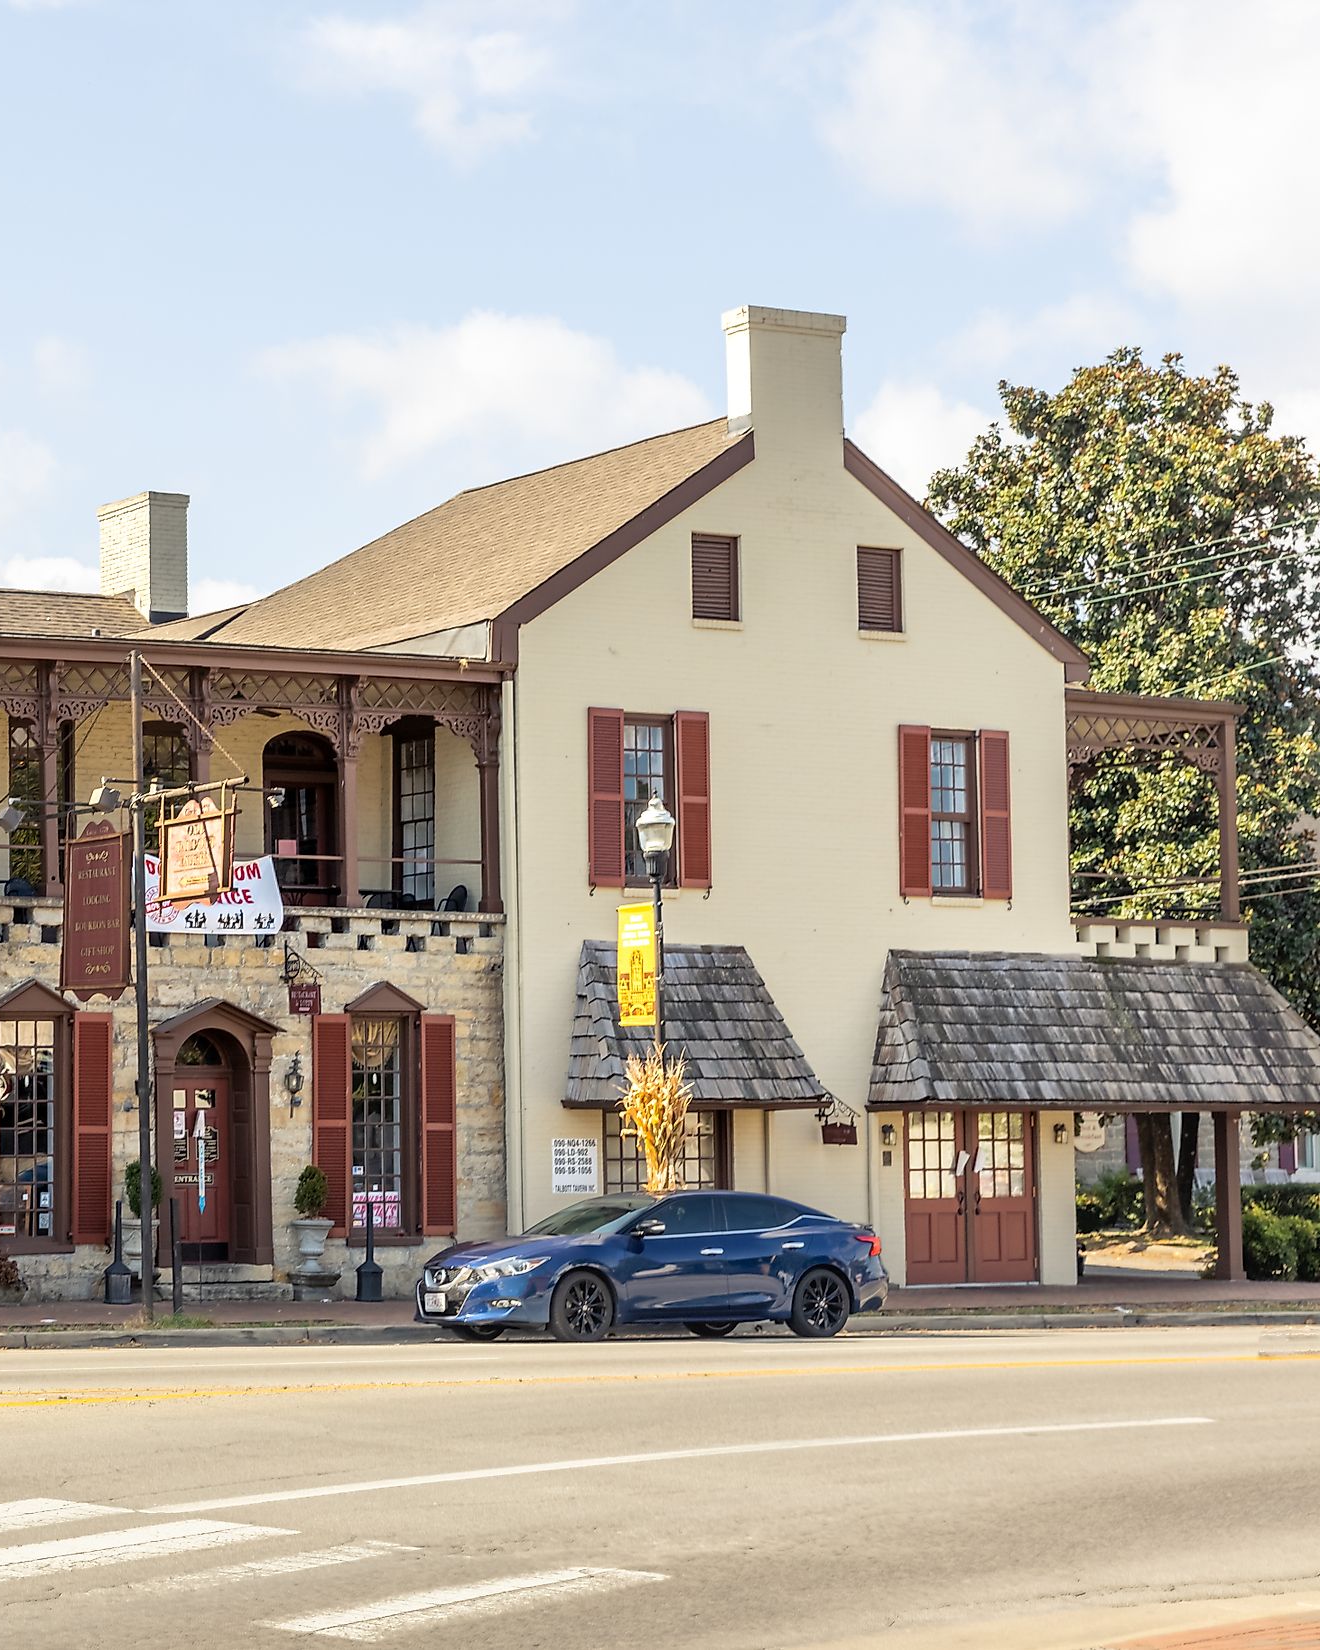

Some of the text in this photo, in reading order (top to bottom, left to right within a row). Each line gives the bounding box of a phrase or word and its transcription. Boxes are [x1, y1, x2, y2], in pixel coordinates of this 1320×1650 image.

[78, 866, 117, 880] RESTAURANT
[234, 862, 262, 881] OM
[82, 894, 111, 906] LODGING
[75, 918, 121, 932] BOURBON BAR
[80, 944, 115, 957] GIFT SHOP
[174, 1175, 212, 1183] ENTRACE
